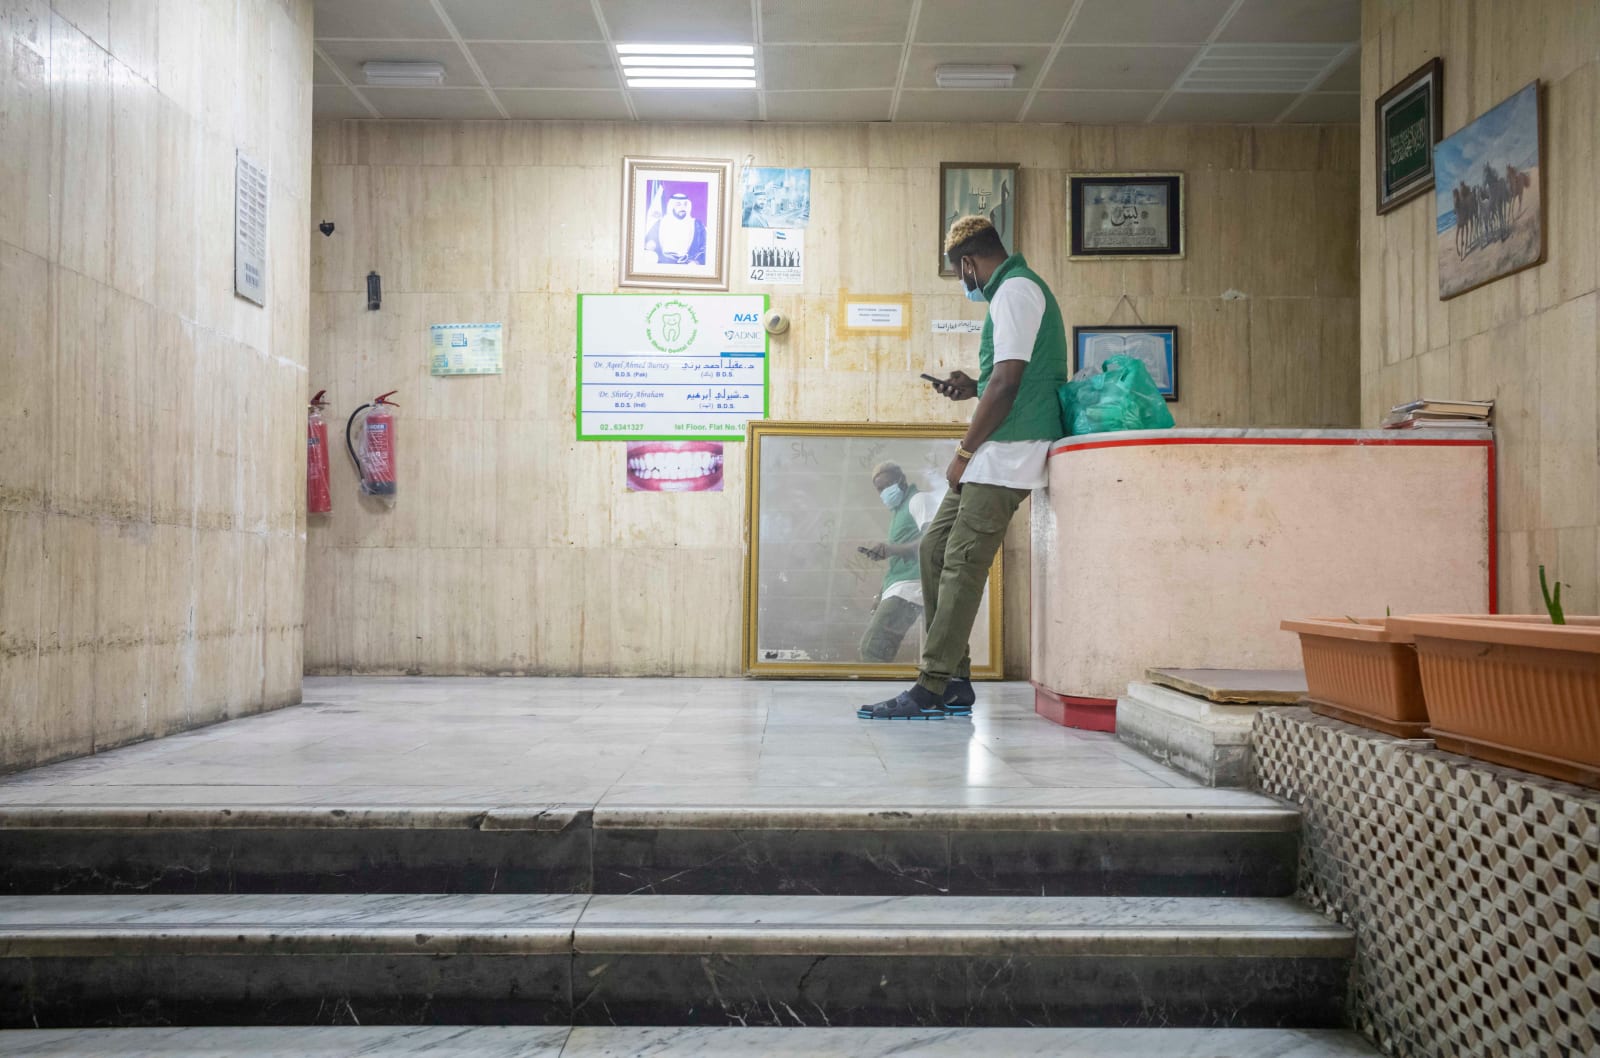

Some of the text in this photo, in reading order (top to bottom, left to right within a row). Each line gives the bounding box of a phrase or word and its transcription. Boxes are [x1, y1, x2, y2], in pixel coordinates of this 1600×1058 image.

[750, 269, 764, 281] 42
[734, 313, 759, 322] NAS
[610, 390, 634, 400] Shirley
